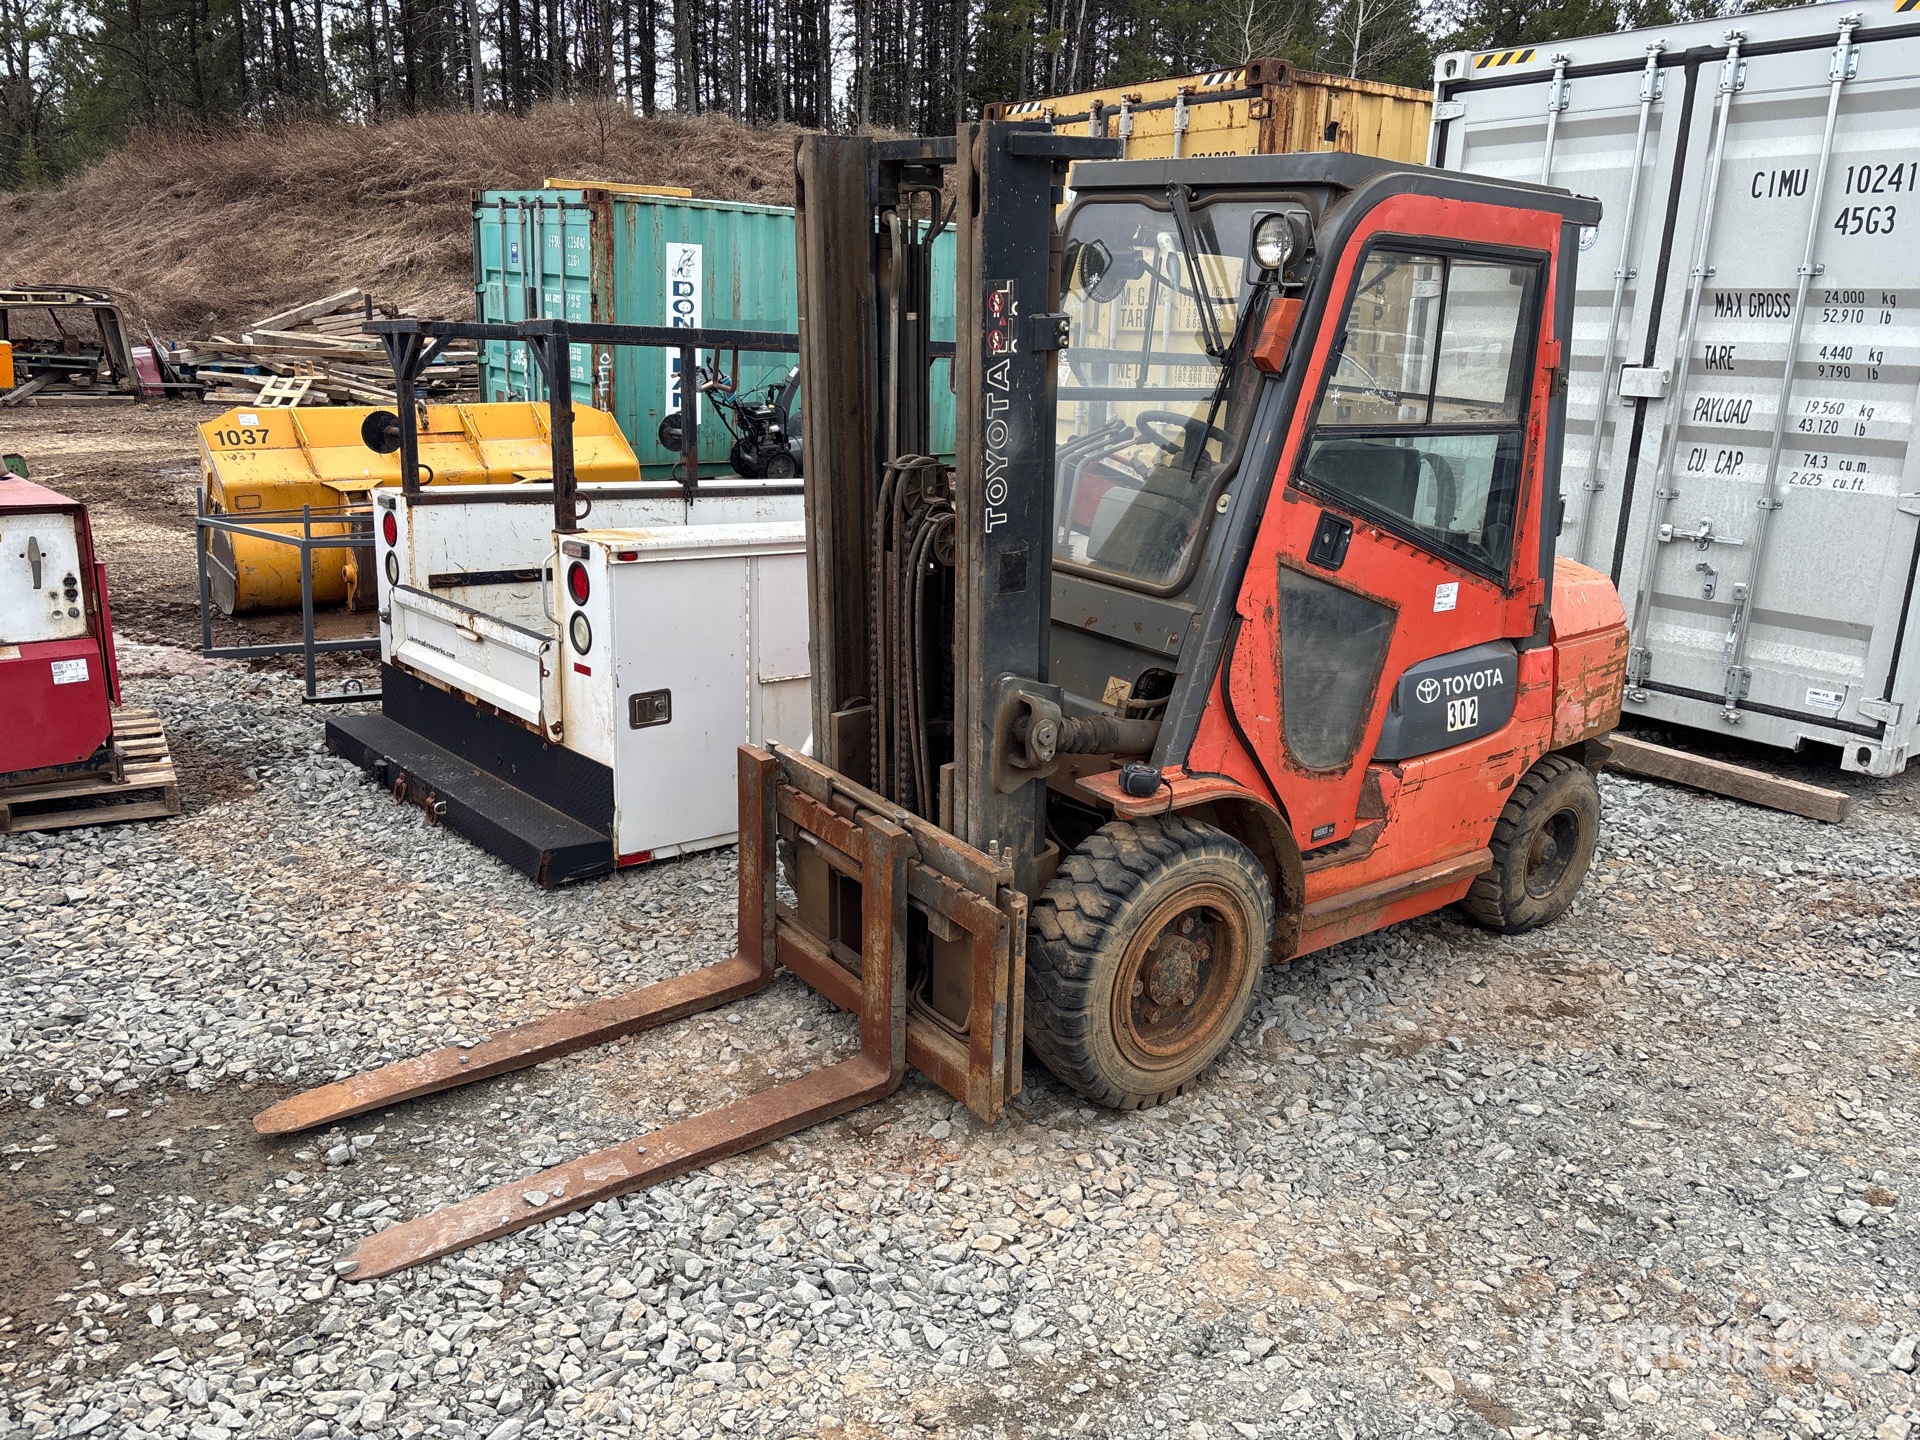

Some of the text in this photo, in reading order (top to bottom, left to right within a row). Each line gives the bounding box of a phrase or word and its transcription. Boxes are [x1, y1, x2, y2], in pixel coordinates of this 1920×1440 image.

[1751, 168, 1809, 198] CIMU
[1834, 206, 1897, 235] 45G3
[1714, 292, 1743, 318] MAX
[1748, 292, 1791, 319] GROSS
[1881, 292, 1897, 308] kg
[1879, 310, 1892, 324] lb
[1704, 345, 1736, 370] TARE
[1868, 348, 1883, 365] kg
[1867, 367, 1879, 380] lb
[1692, 397, 1752, 424] PAYLOAD
[1858, 404, 1875, 421] kg
[214, 429, 269, 446] 1037
[1853, 422, 1866, 436] lb
[985, 358, 1011, 534] TOYOTA
[1687, 448, 1708, 473] CU.
[1714, 449, 1744, 475] CAP.
[1803, 453, 1828, 469] 74.3
[1442, 668, 1504, 696] TOYOTA
[1449, 698, 1478, 729] 302
